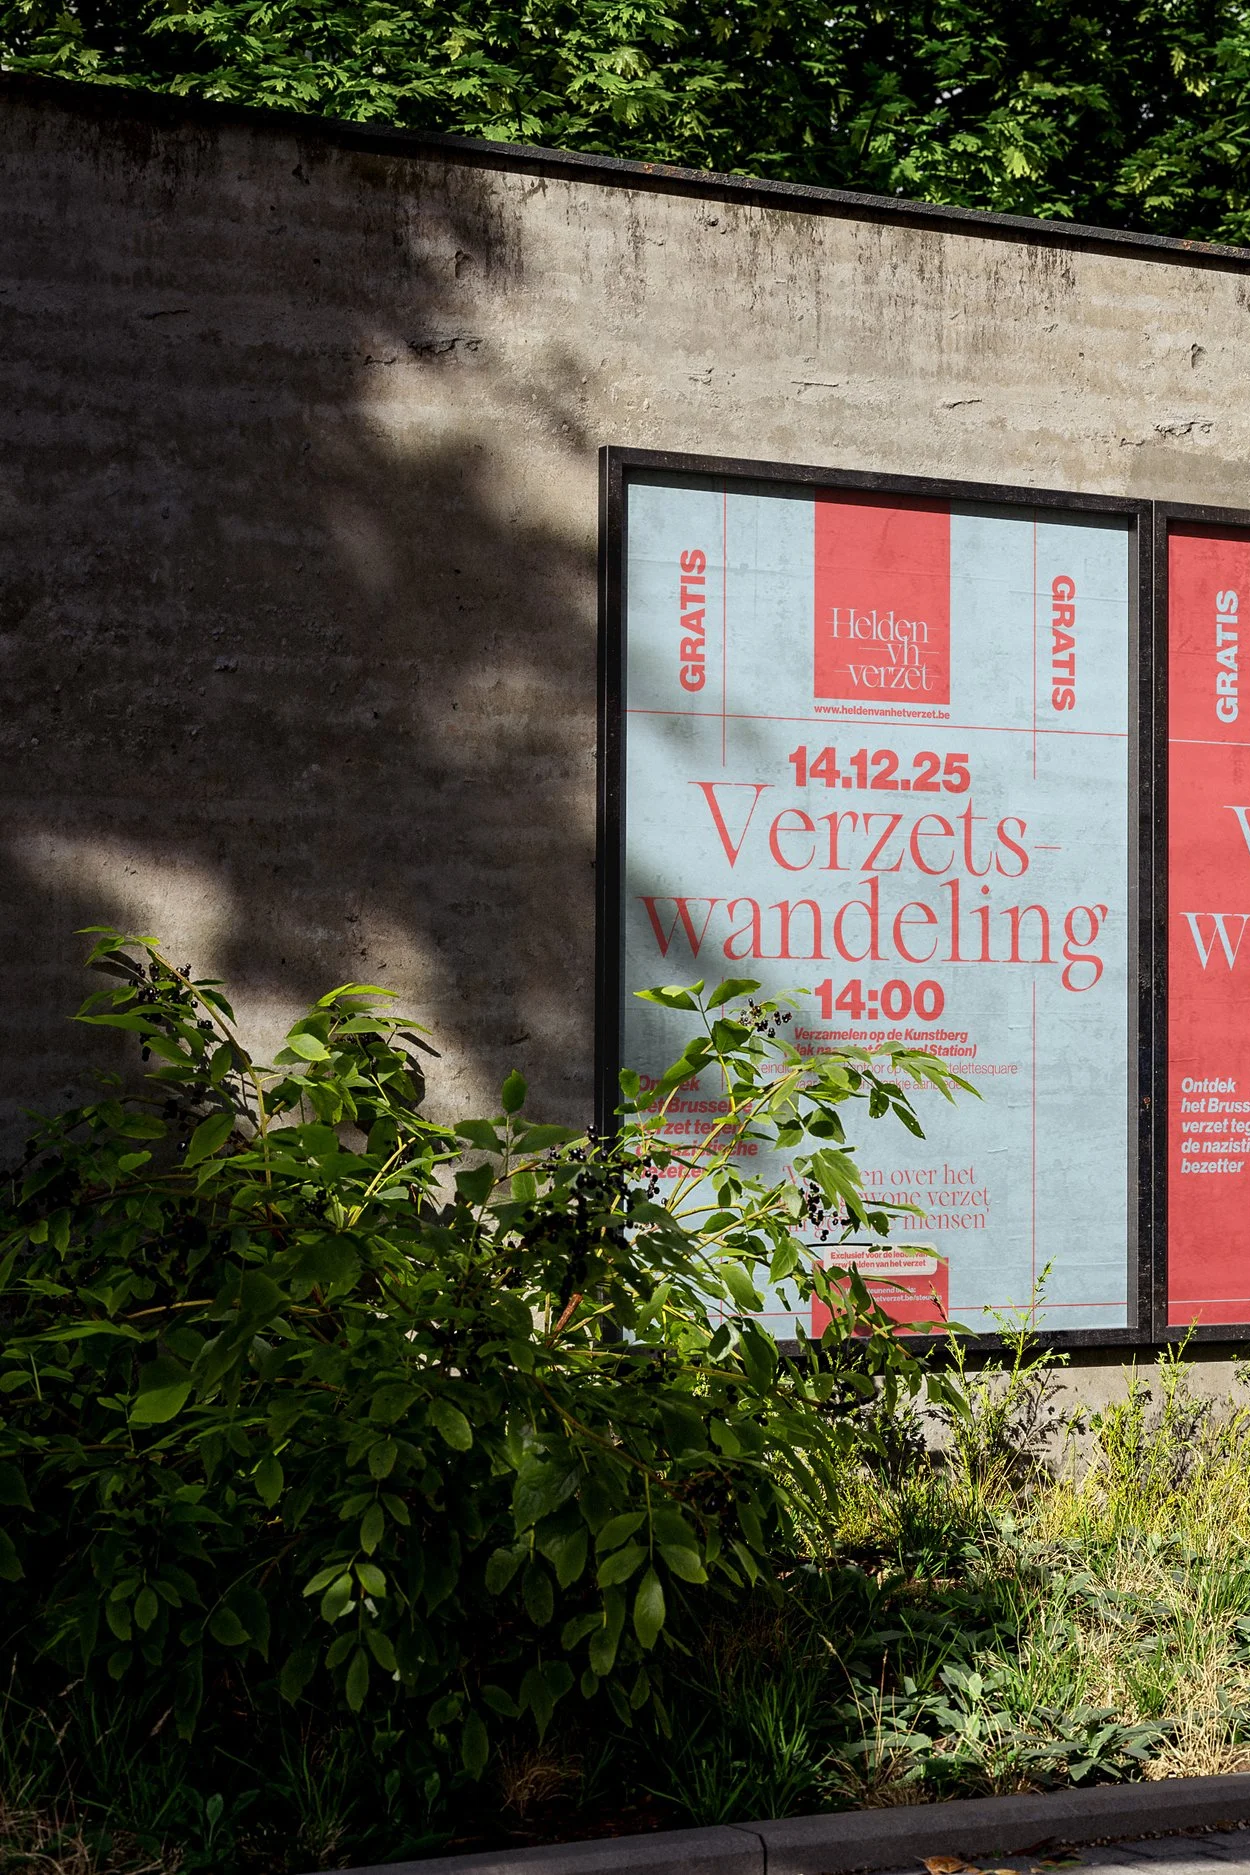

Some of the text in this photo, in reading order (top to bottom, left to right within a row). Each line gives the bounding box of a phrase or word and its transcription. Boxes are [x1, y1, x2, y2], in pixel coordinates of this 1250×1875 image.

[679, 549, 707, 693] GRATIS
[831, 607, 931, 644] Helden
[1052, 574, 1077, 712] GRATIS
[1216, 589, 1239, 724] GRATIS
[848, 659, 933, 691] verzet
[814, 704, 950, 720] www.heldenvanhetverzet.be
[789, 746, 971, 794] 14.12.25
[688, 782, 1063, 876] Verzets-
[635, 876, 1109, 992] wandeling
[814, 979, 945, 1021] 14:00
[794, 1027, 969, 1043] Verzamelen op de Kunstberg
[929, 1044, 978, 1059] Station)
[1181, 1078, 1236, 1093] Ontdek
[1181, 1099, 1206, 1113] het
[1181, 1119, 1228, 1132] verzet
[1181, 1138, 1201, 1153] de
[891, 1169, 937, 1186] over
[943, 1164, 978, 1186] het
[1181, 1159, 1244, 1174] bezetter
[928, 1187, 990, 1208] verzet
